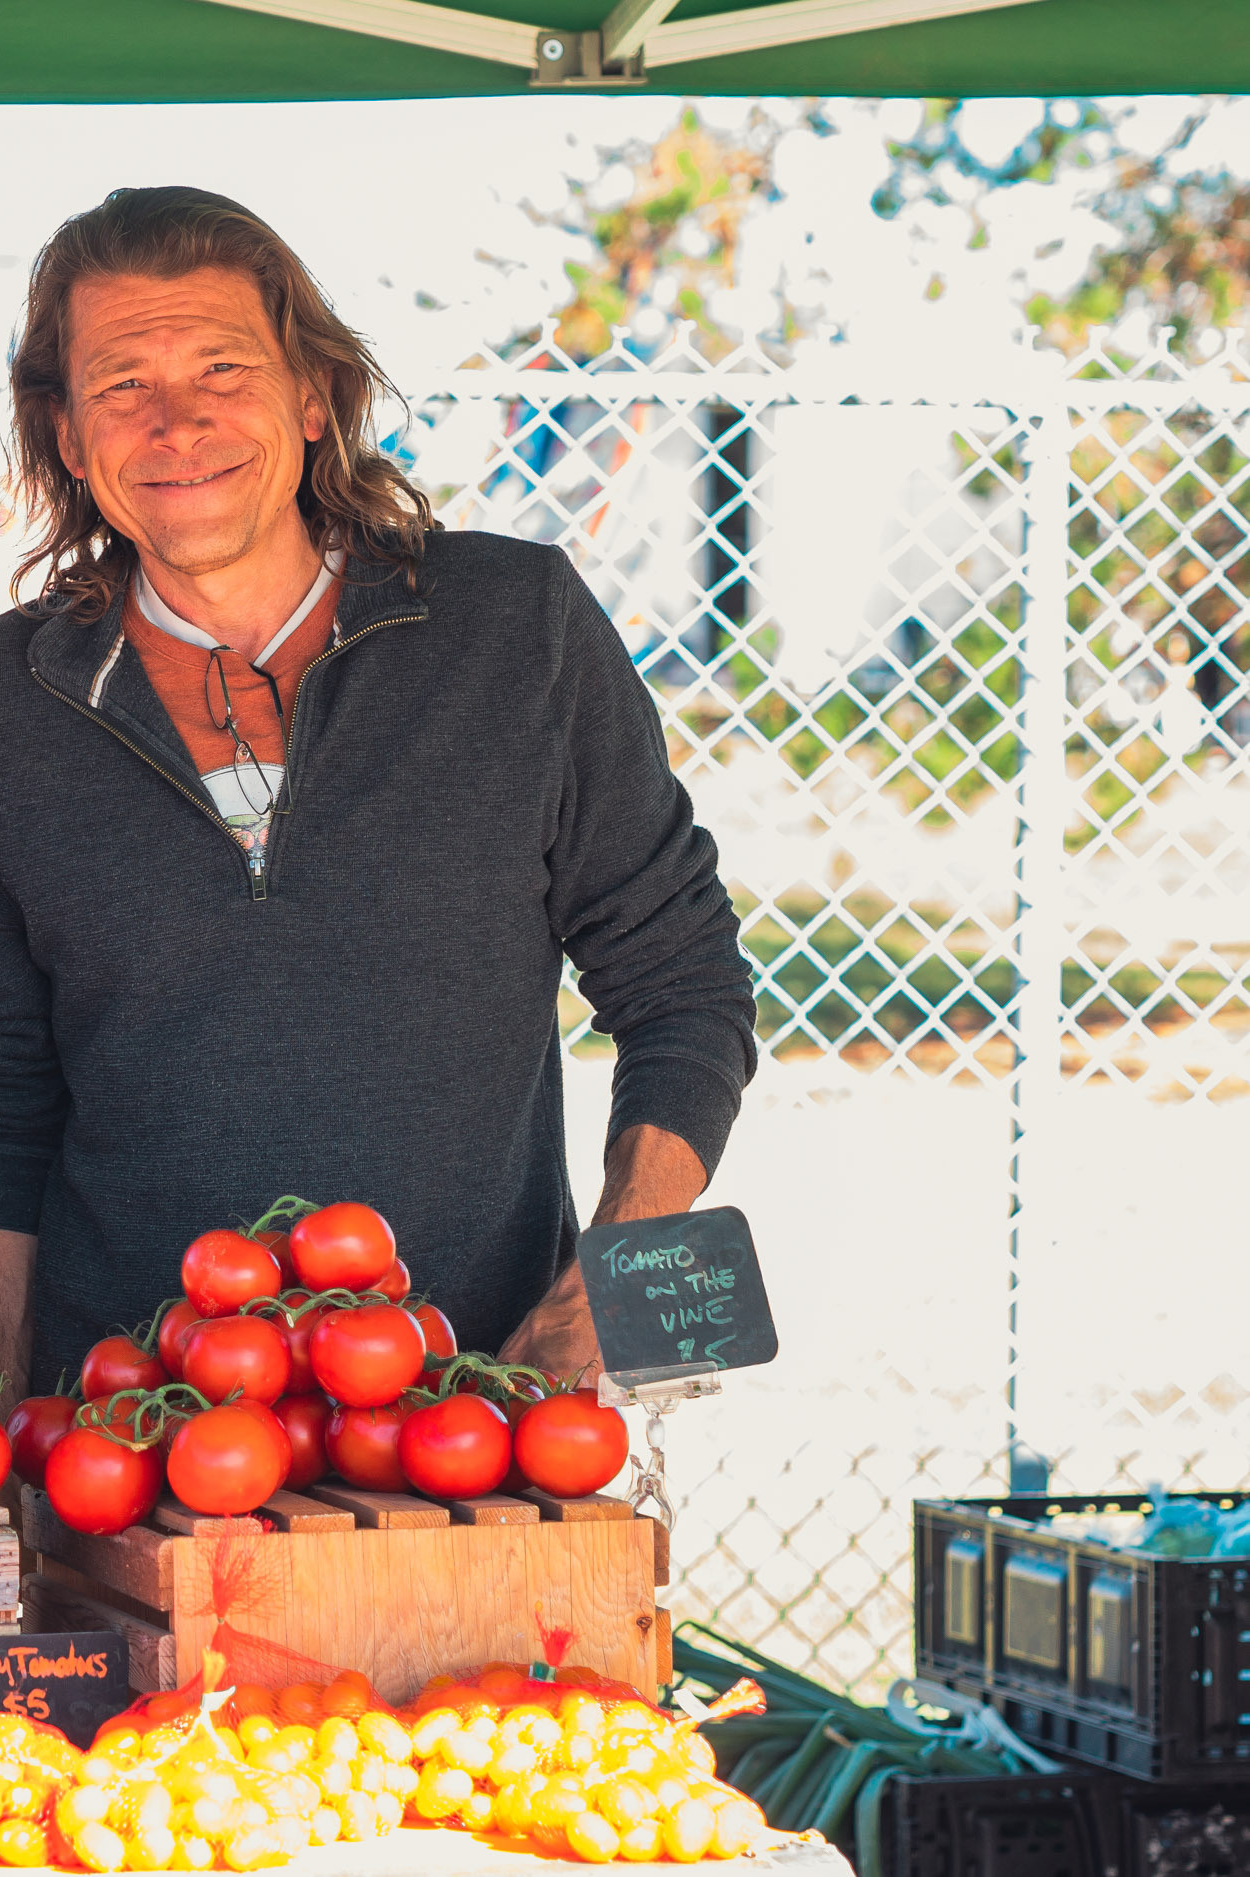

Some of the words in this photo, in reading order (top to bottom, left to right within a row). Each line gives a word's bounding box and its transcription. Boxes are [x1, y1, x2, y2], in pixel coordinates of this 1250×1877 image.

[601, 1238, 696, 1278] TOMATO
[684, 1265, 736, 1293] THE
[660, 1295, 734, 1334] VINE
[2, 1688, 50, 1720] $5
